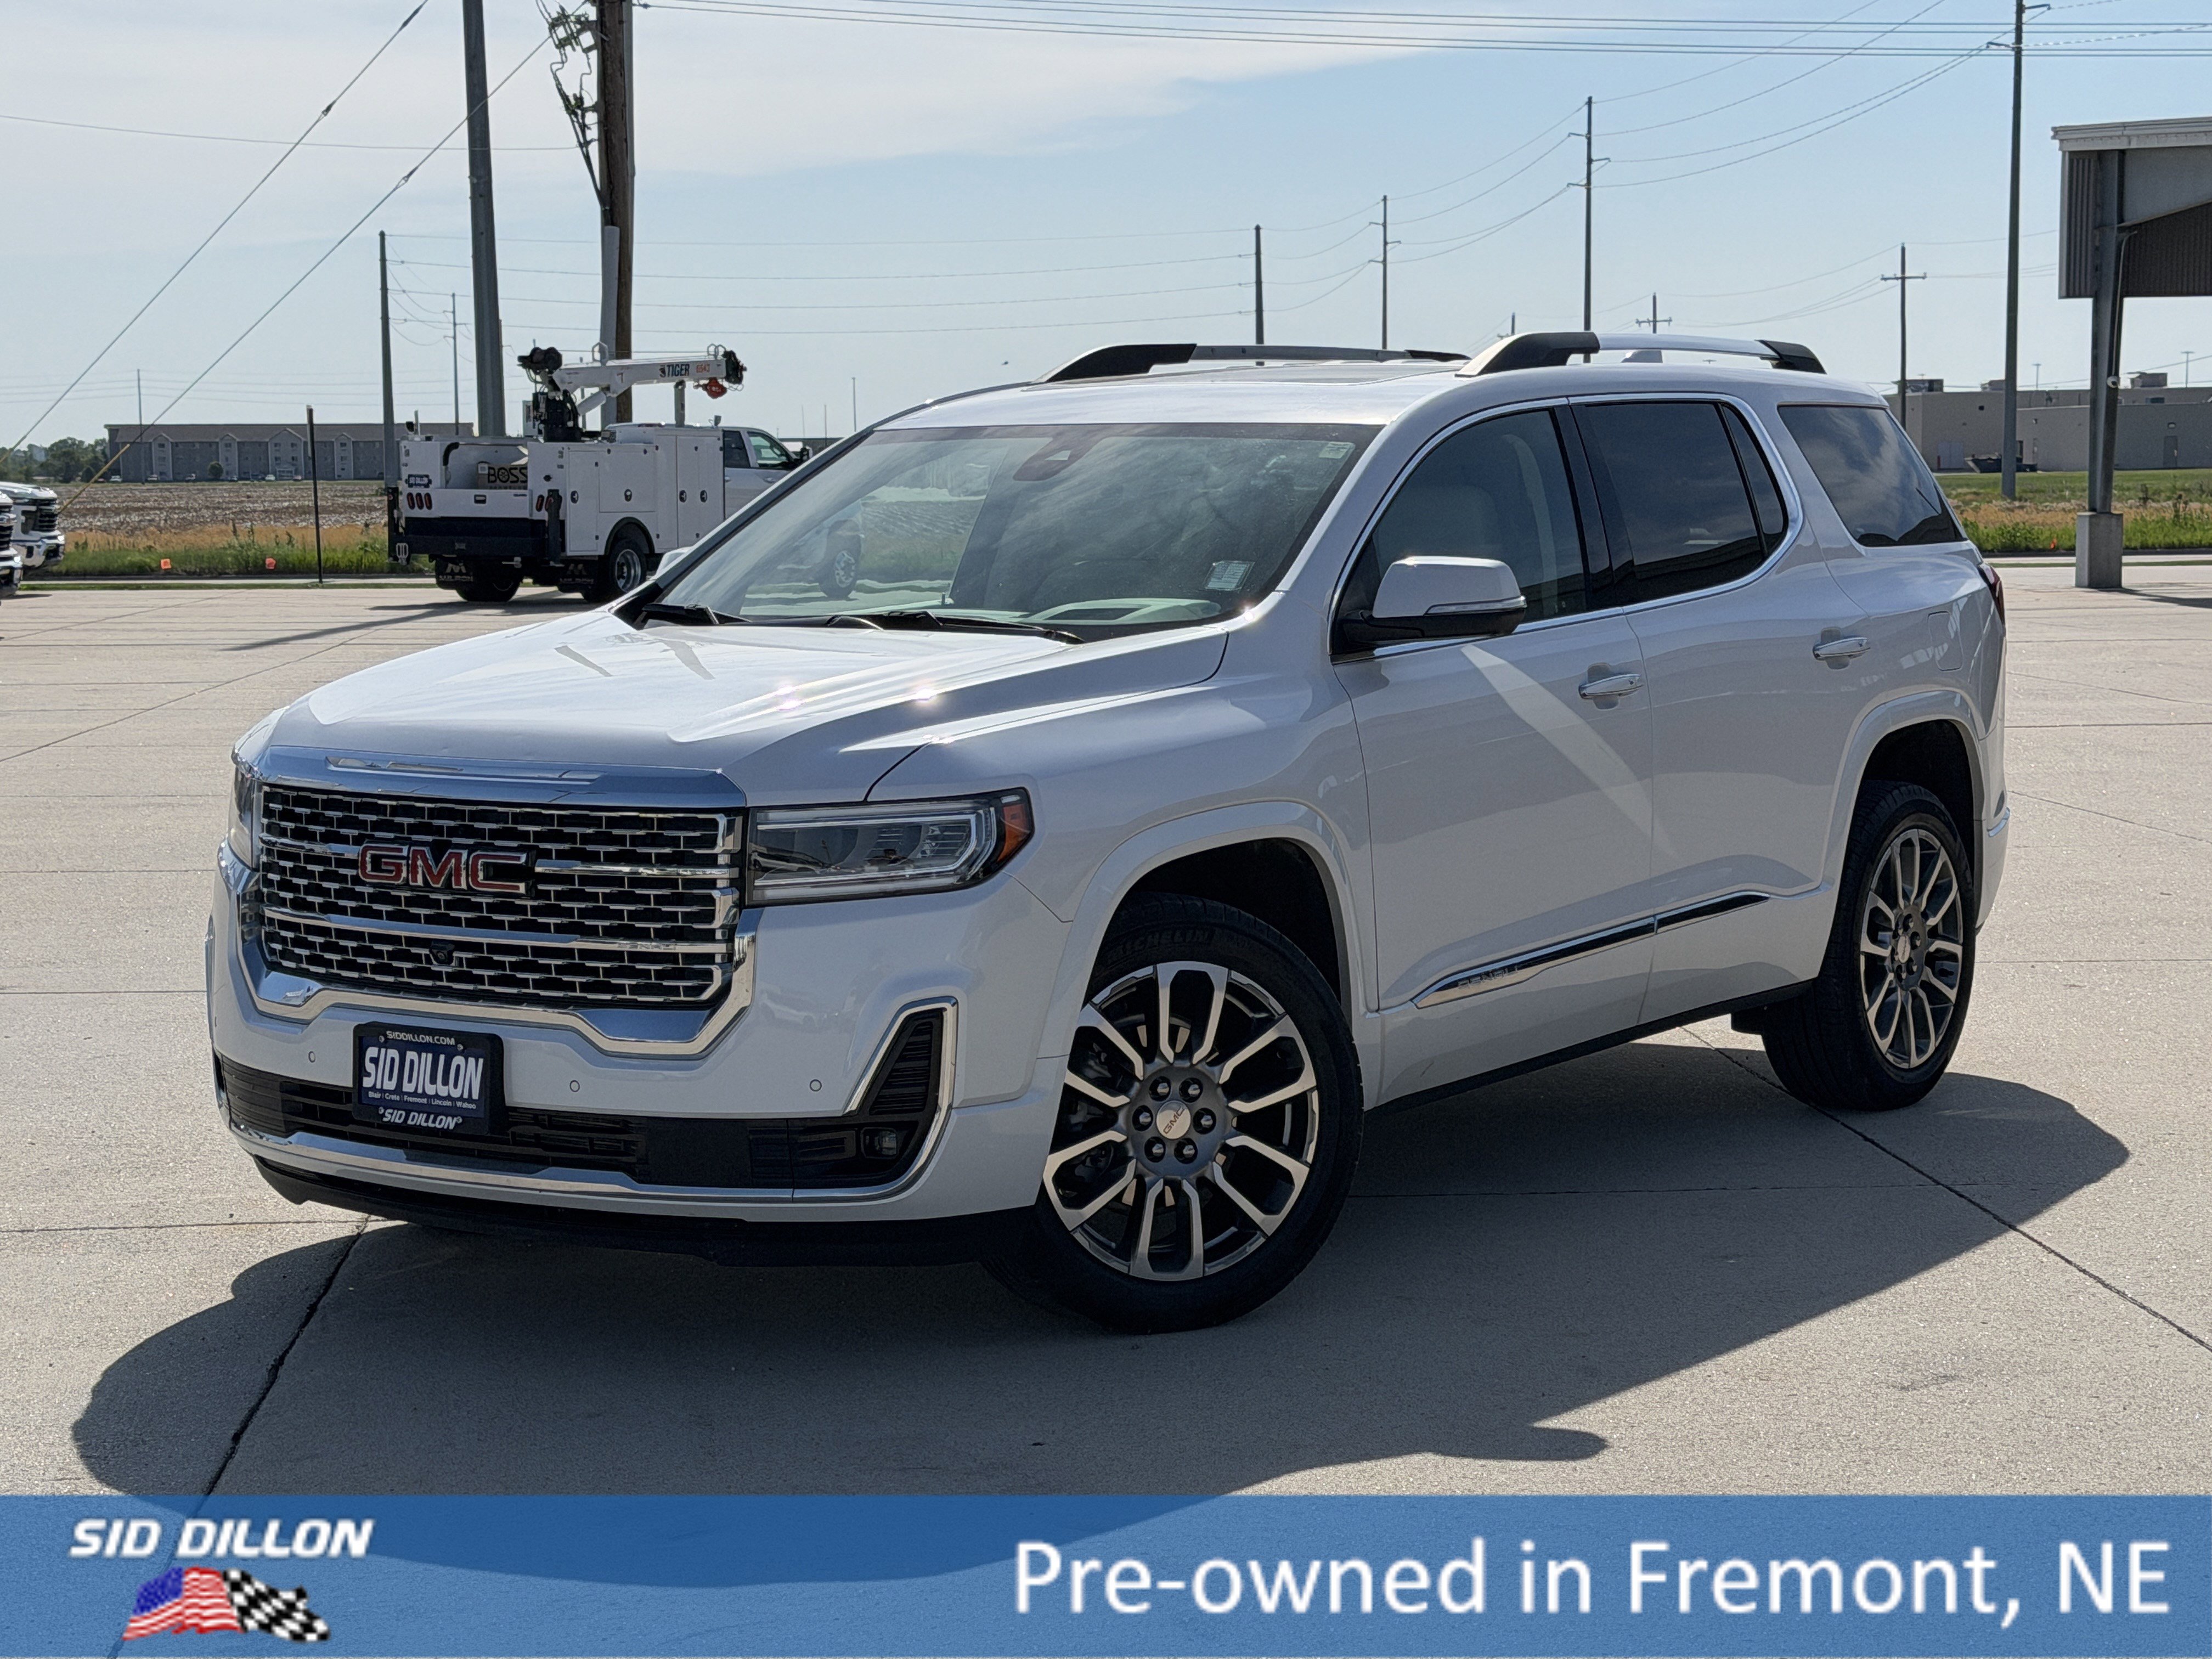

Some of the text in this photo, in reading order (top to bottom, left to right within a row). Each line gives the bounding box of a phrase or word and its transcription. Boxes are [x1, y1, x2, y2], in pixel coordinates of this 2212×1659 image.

[667, 363, 690, 377] TIGER
[488, 467, 528, 483] BOSS
[358, 843, 527, 895] GMC
[386, 1031, 455, 1045] SIDDILLON.COM
[363, 1047, 483, 1099] SID DILLON
[404, 1095, 427, 1104] Fremont
[431, 1098, 452, 1107] Lincoln
[382, 1109, 457, 1130] SID DILLON
[1163, 1104, 1186, 1135] GMC
